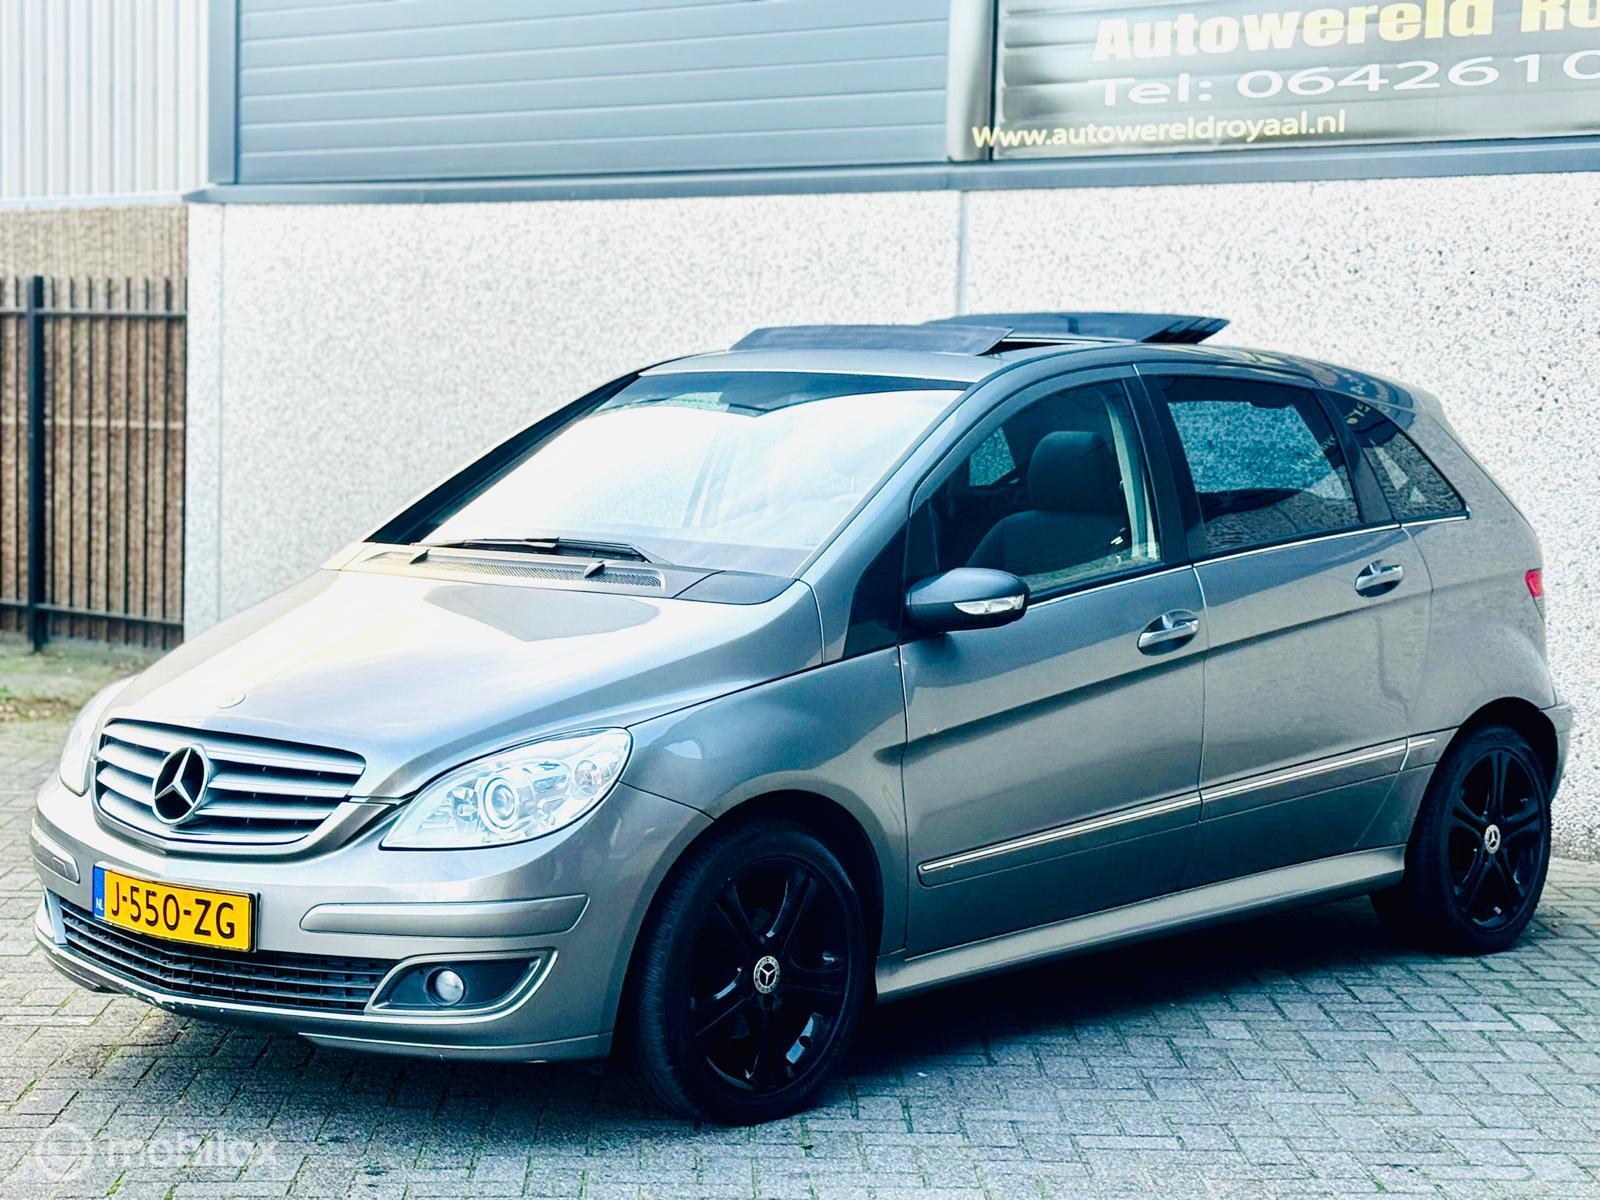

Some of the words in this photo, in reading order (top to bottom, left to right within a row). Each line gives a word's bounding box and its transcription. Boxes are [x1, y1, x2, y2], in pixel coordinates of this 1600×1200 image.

[1094, 0, 1494, 62] Autowereld
[1087, 72, 1213, 106] Tel:
[95, 897, 104, 911] NL
[111, 881, 236, 940] J-550-ZG
